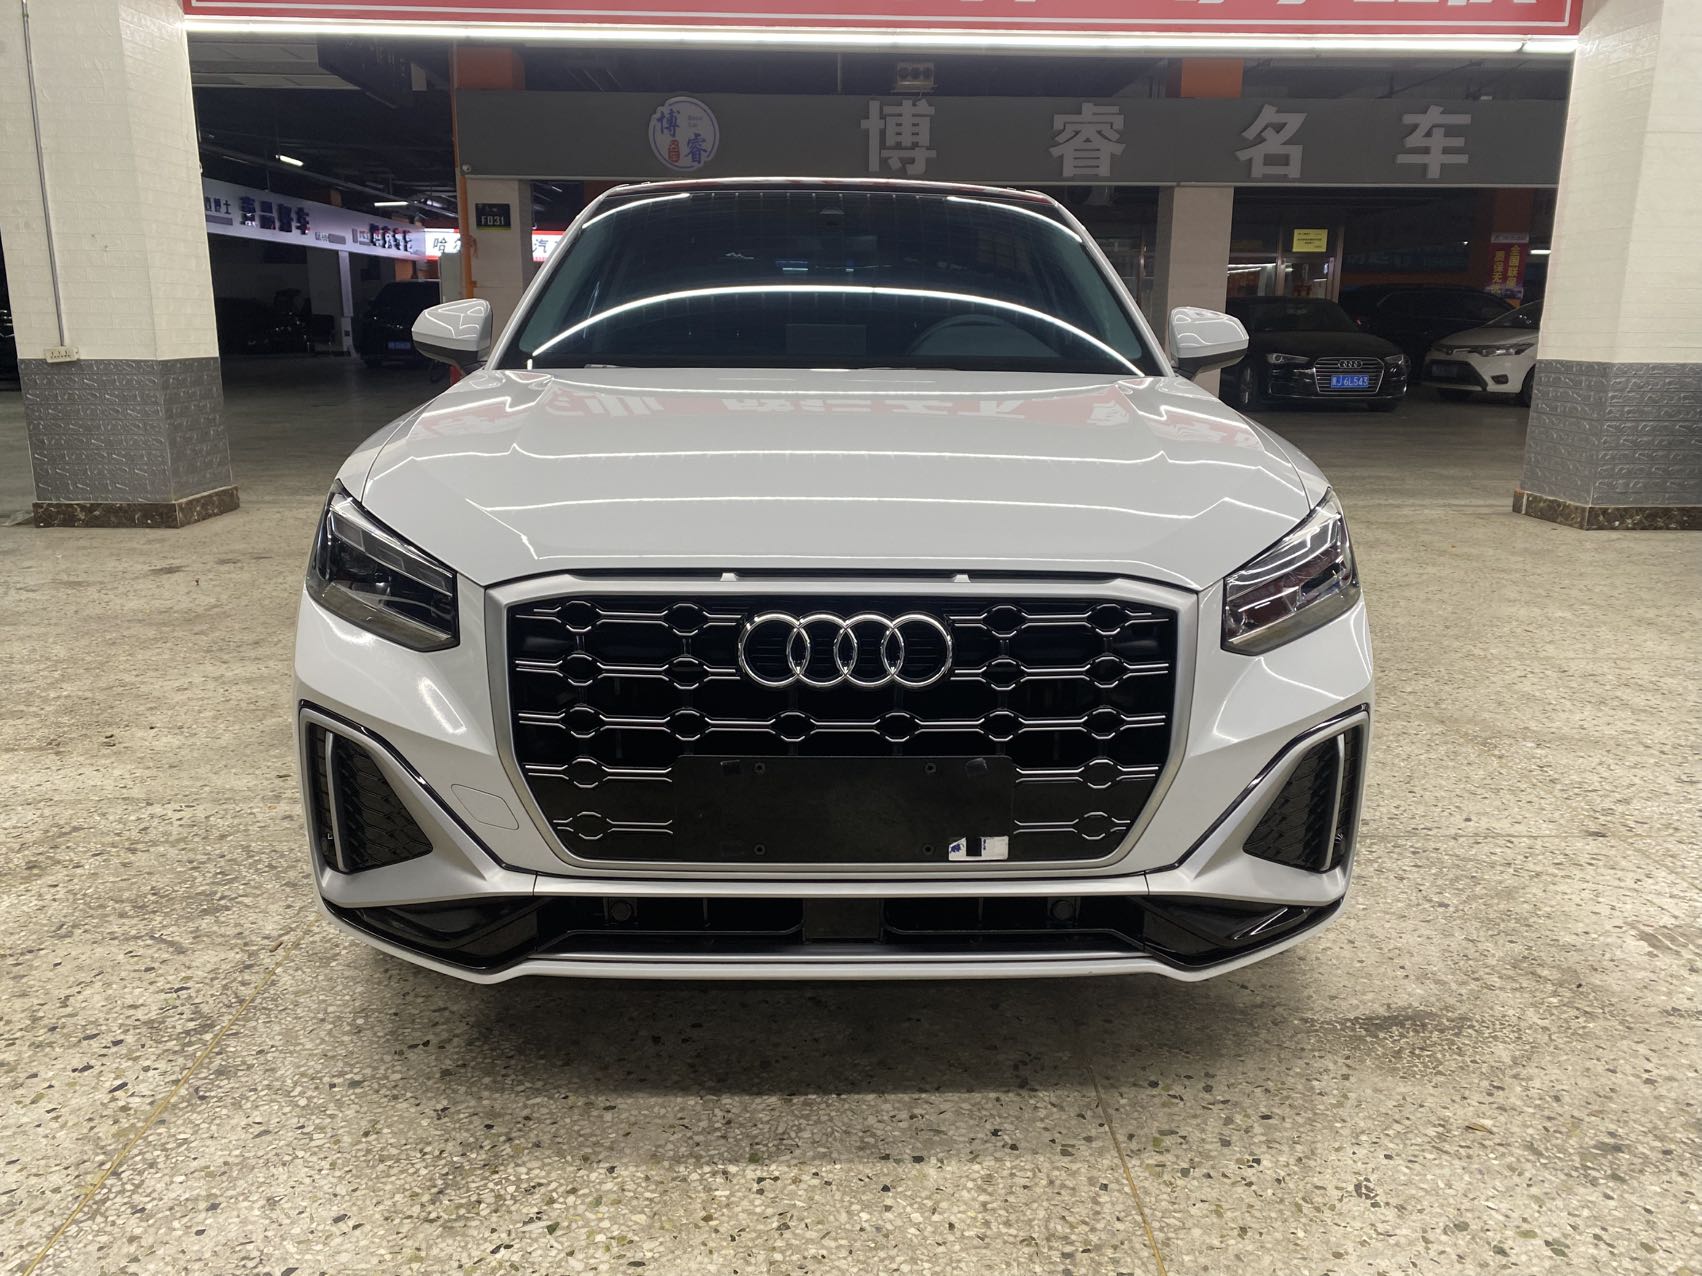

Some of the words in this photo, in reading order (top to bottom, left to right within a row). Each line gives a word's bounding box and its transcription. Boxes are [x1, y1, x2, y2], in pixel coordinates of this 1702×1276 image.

[656, 107, 680, 138] 博
[684, 132, 707, 165] 睿
[860, 98, 1472, 179] 博睿名车
[481, 215, 504, 225] F031
